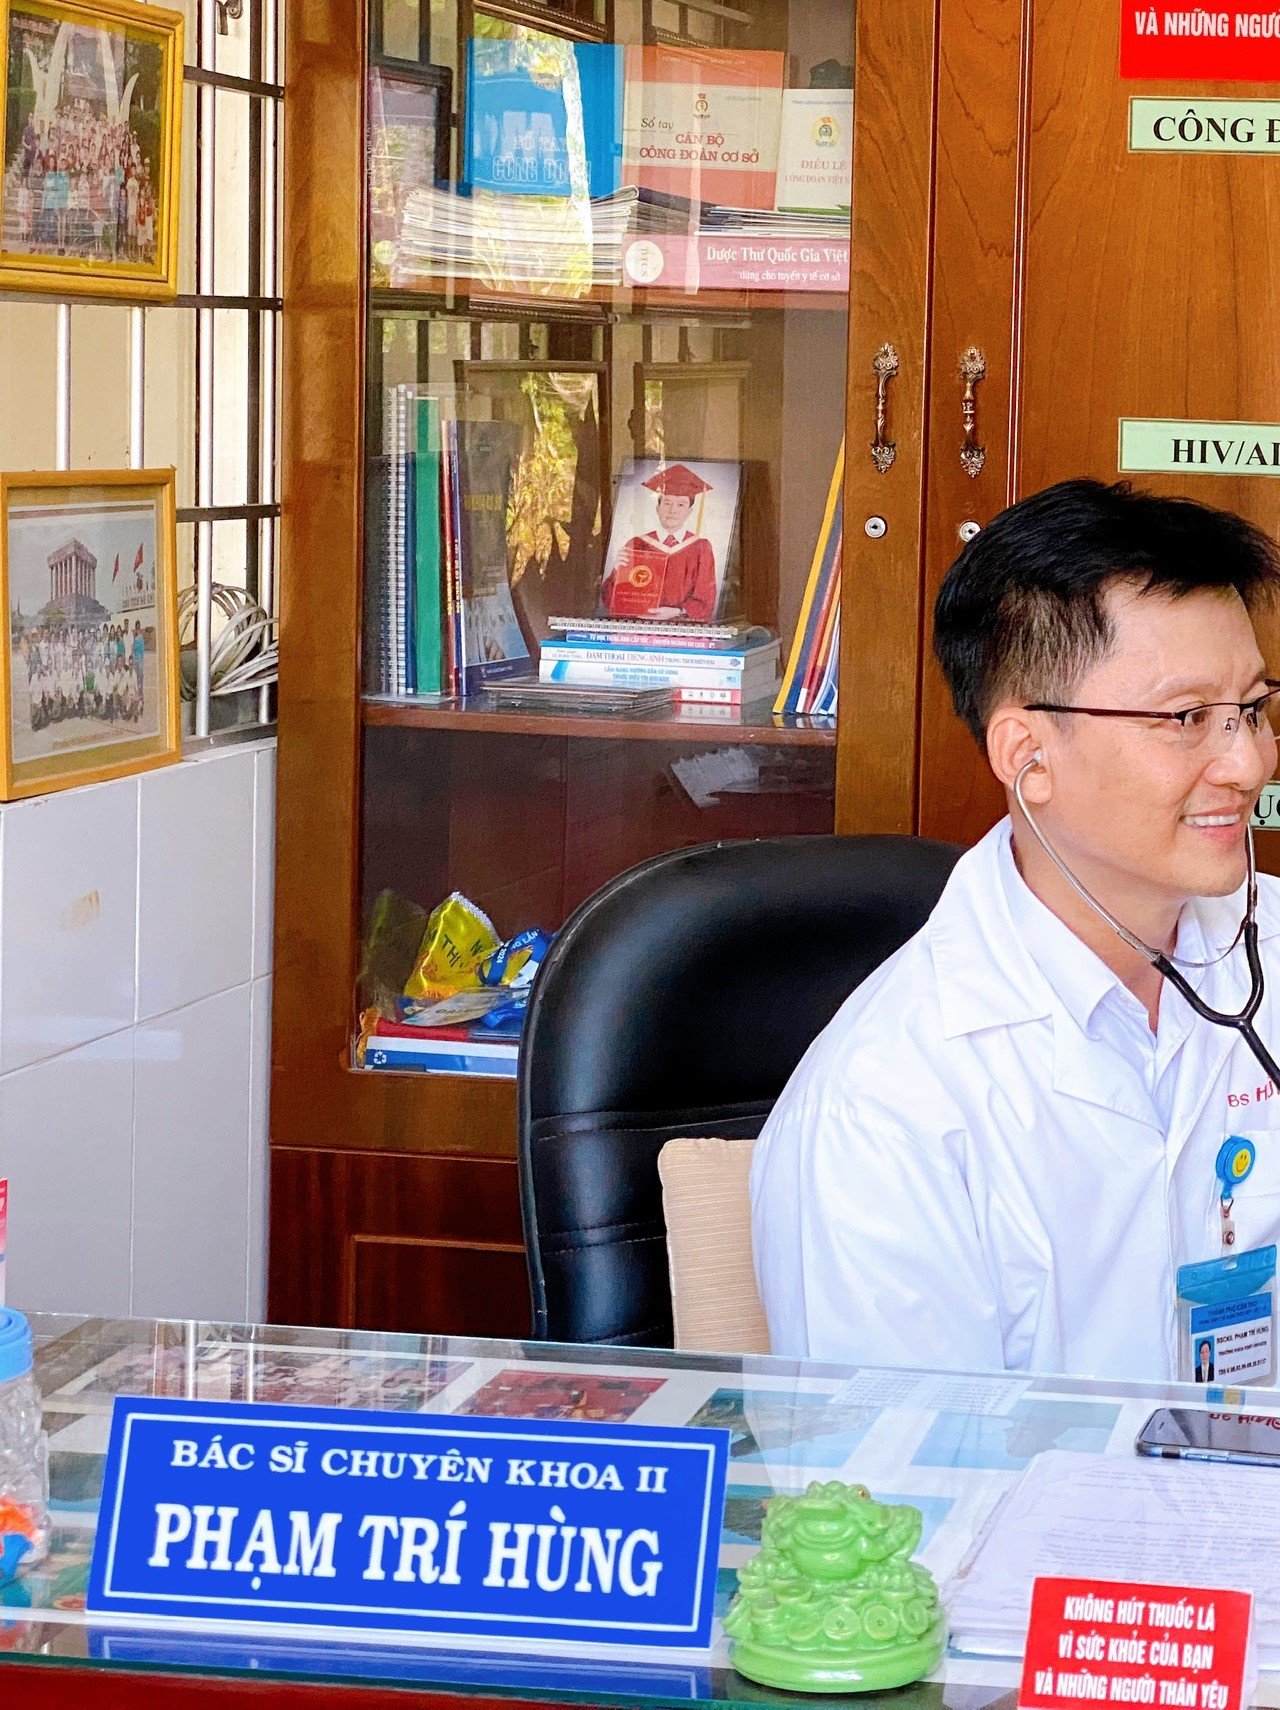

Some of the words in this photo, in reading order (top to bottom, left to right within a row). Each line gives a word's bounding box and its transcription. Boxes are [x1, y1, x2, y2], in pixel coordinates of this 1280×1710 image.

[1135, 10, 1158, 36] VÀ
[1164, 8, 1228, 37] NHỮNG
[641, 117, 656, 128] Sổ
[658, 120, 674, 130] tay
[1153, 109, 1256, 143] CÔNG
[639, 145, 675, 160] CÔNG
[706, 133, 725, 148] BỘ
[707, 246, 738, 263] Dược
[741, 246, 765, 261] Thư
[767, 246, 798, 264] Quốc
[800, 248, 820, 262] Gia
[823, 248, 848, 265] Việt
[1227, 1093, 1250, 1108] BS
[170, 1434, 255, 1471] BÁC
[269, 1440, 309, 1473] SĨ
[321, 1448, 493, 1484] CHUYÊN
[505, 1459, 624, 1491] KHOA
[636, 1466, 669, 1494] II
[147, 1503, 343, 1591] PHẠM
[358, 1500, 467, 1585] TRÍ
[482, 1504, 663, 1597] HÙNG
[1063, 1593, 1114, 1623] KHÔNG
[1117, 1596, 1144, 1625] HÚT
[1148, 1598, 1194, 1630] THUỐC
[1197, 1603, 1215, 1631] LÁ
[1059, 1630, 1074, 1659] VÌ
[1075, 1629, 1105, 1661] SỨC
[1108, 1630, 1147, 1664] KHỎE
[1151, 1632, 1178, 1667] CỦA
[1182, 1644, 1213, 1674] BẠN
[1034, 1667, 1053, 1696] VÀ
[1056, 1668, 1107, 1700] NHỮNG
[1110, 1673, 1155, 1704] NGƯỜI
[1159, 1677, 1197, 1707] THÂN
[1201, 1680, 1228, 1709] YÊU
